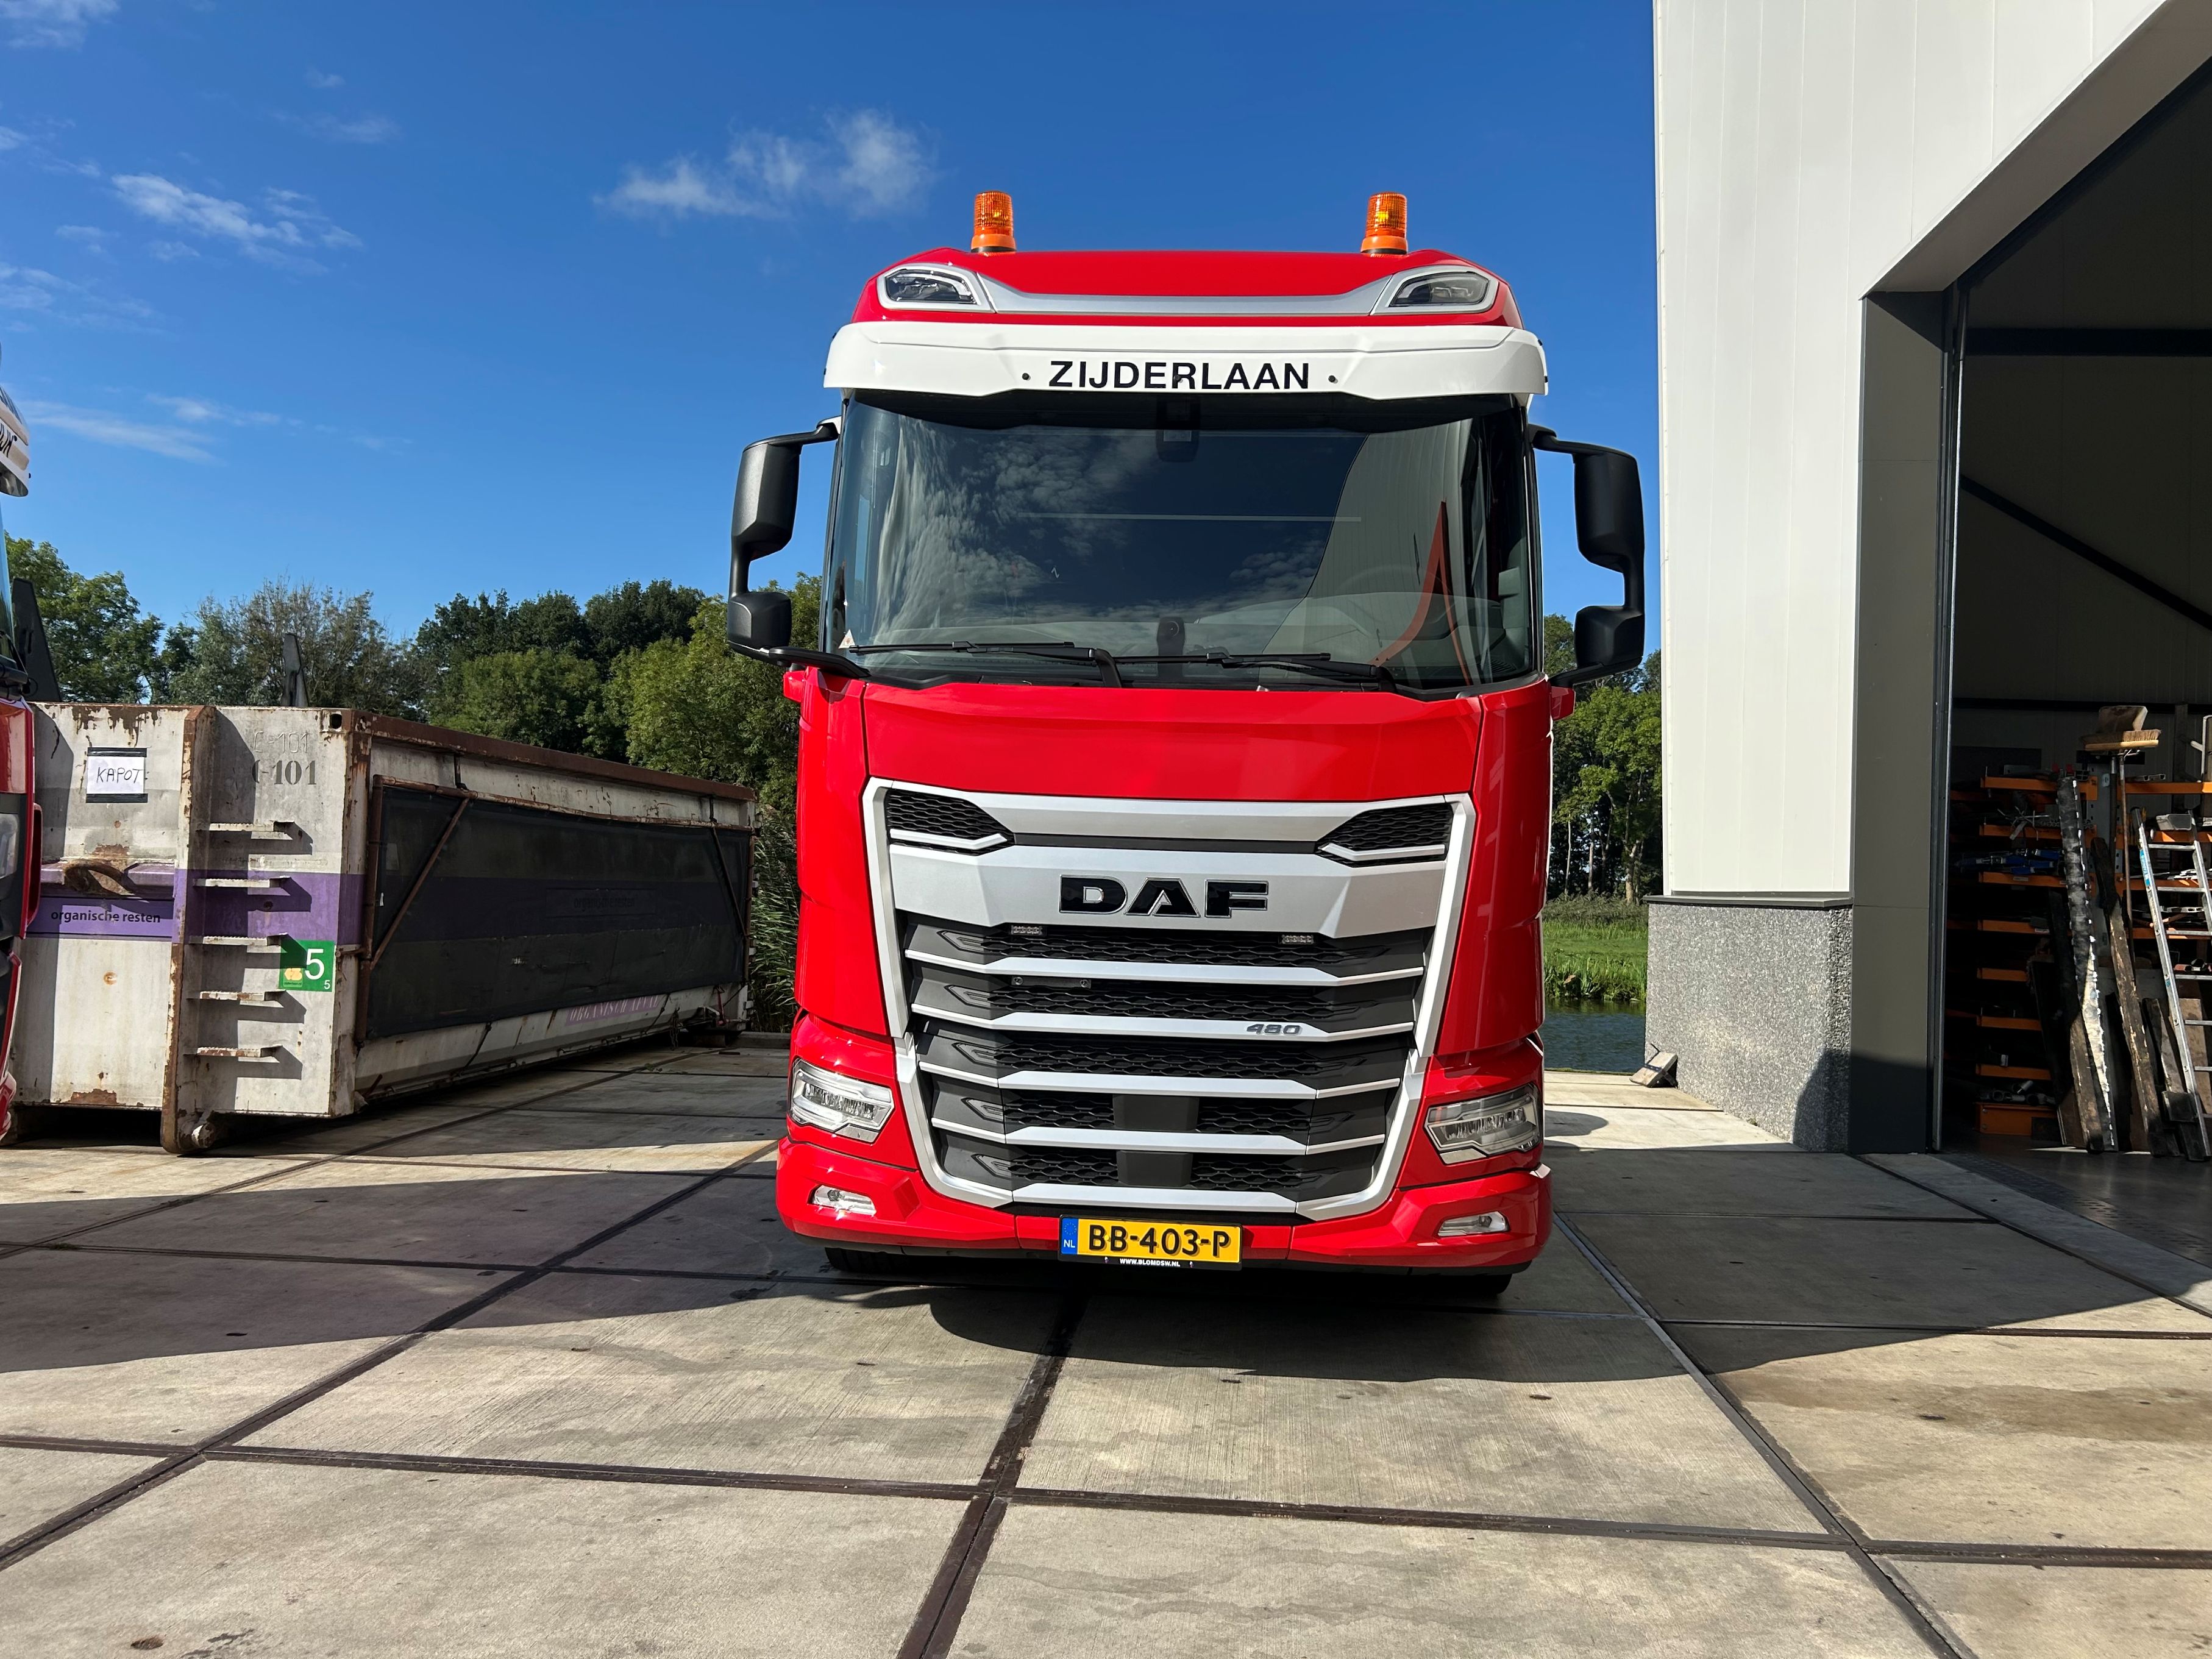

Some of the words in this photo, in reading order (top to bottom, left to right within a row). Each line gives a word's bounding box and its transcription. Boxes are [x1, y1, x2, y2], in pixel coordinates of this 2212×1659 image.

[1049, 361, 1309, 390] ZIJDERLAAN
[96, 766, 144, 784] KAPOT
[1059, 874, 1269, 918] DAF
[51, 910, 120, 923] organische
[123, 912, 161, 923] resten
[305, 948, 325, 980] 5
[324, 979, 330, 990] 5
[1246, 1023, 1301, 1035] 480
[1064, 1239, 1076, 1248] NL
[1089, 1224, 1230, 1257] BB-403-P
